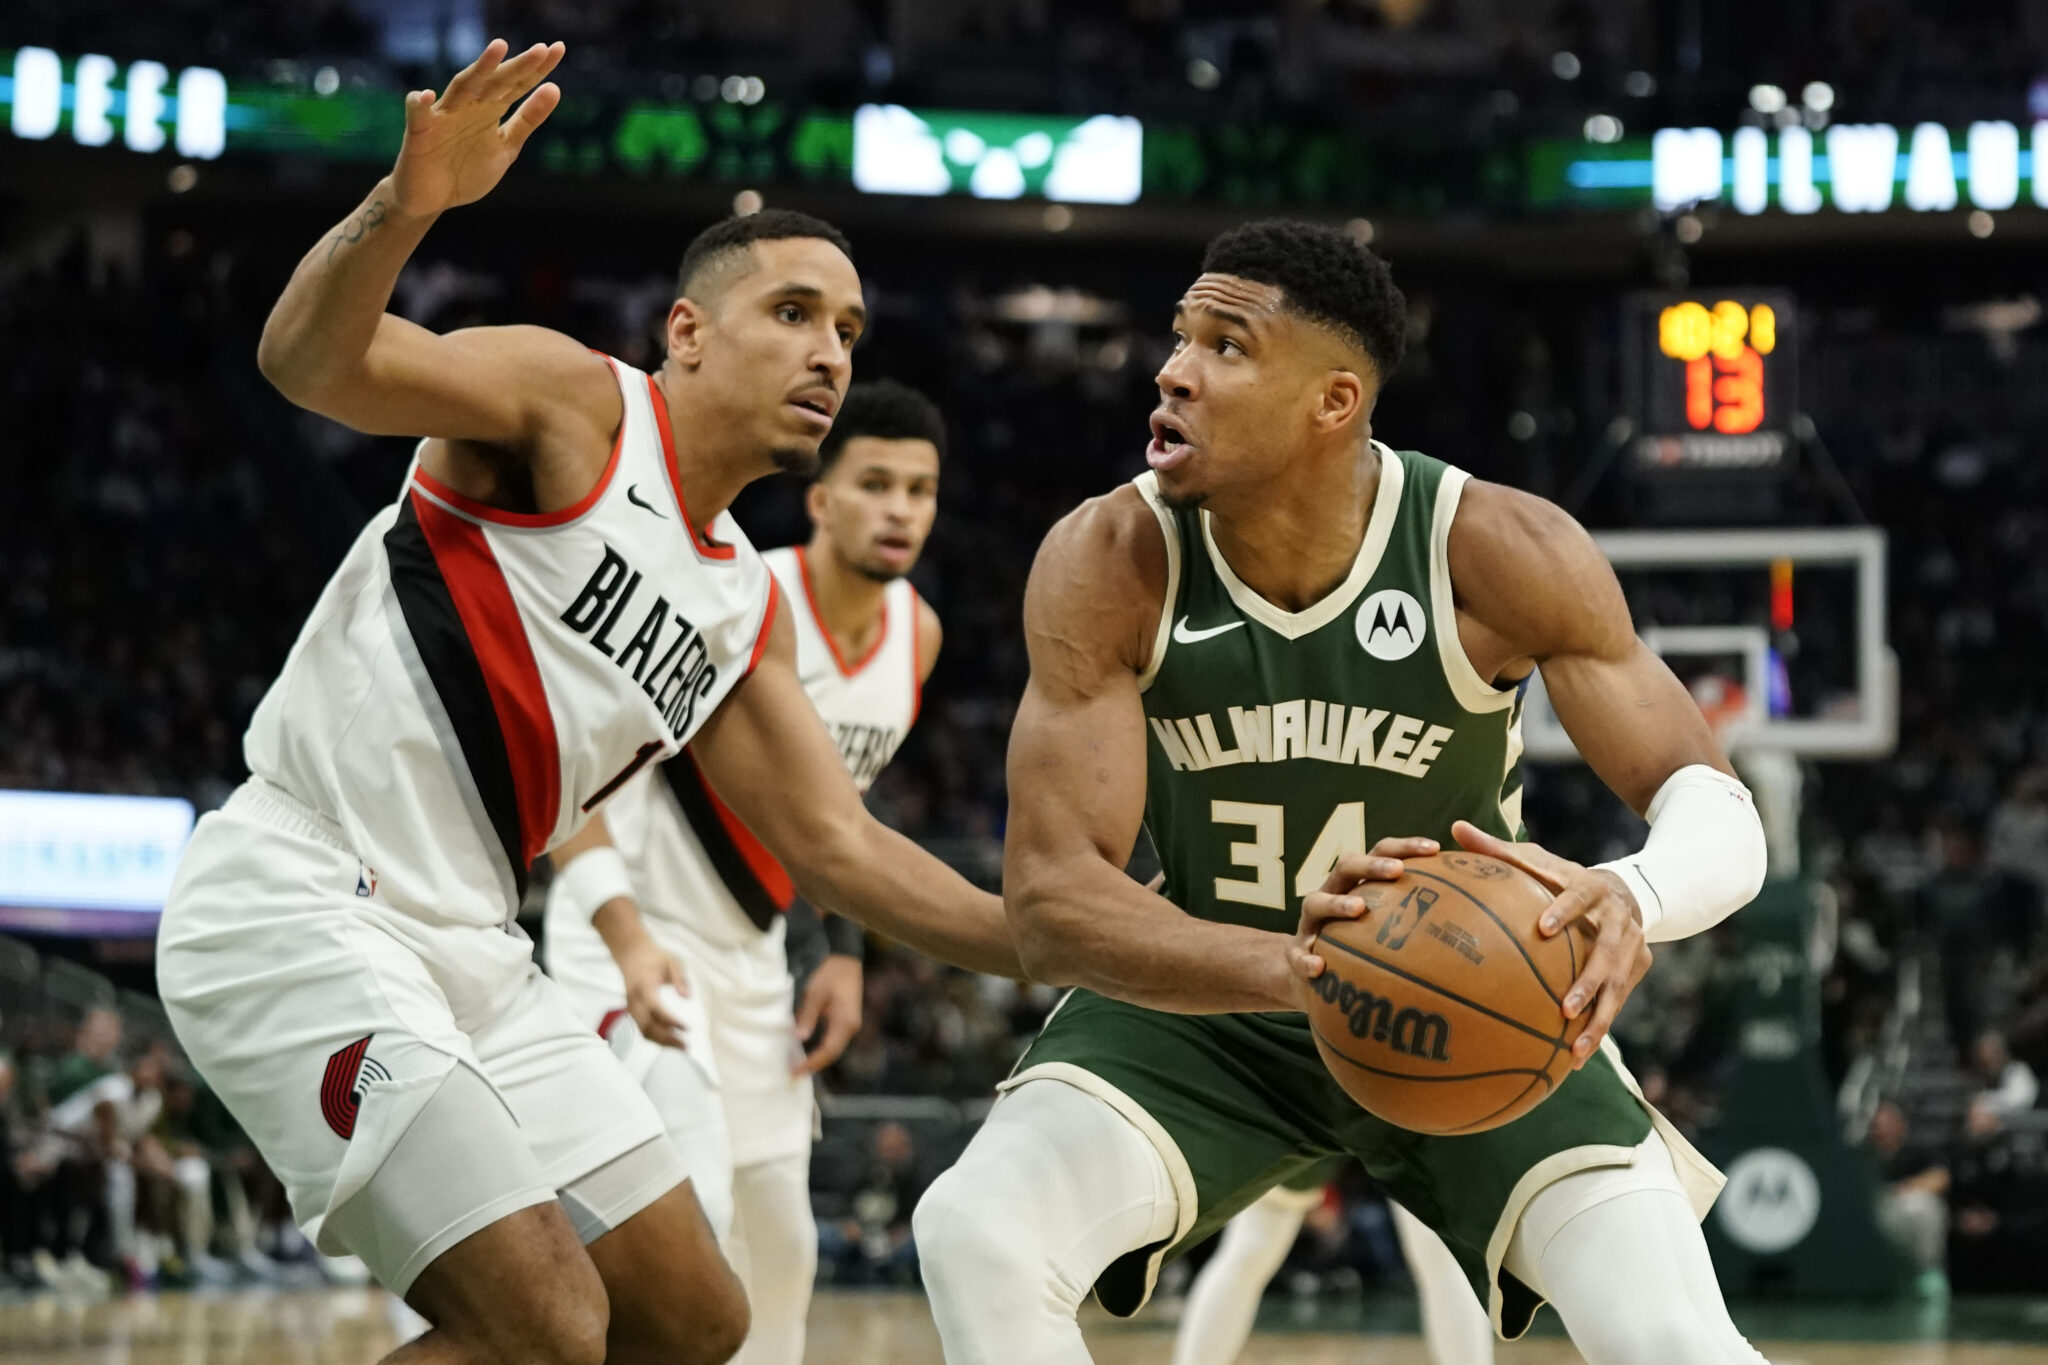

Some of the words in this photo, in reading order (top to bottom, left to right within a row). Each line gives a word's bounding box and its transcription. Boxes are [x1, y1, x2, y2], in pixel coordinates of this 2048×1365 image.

[560, 541, 718, 741] BLAZERS
[581, 738, 669, 813] 1
[1149, 699, 1454, 778] MILWAUKEE
[1211, 799, 1367, 911] 34
